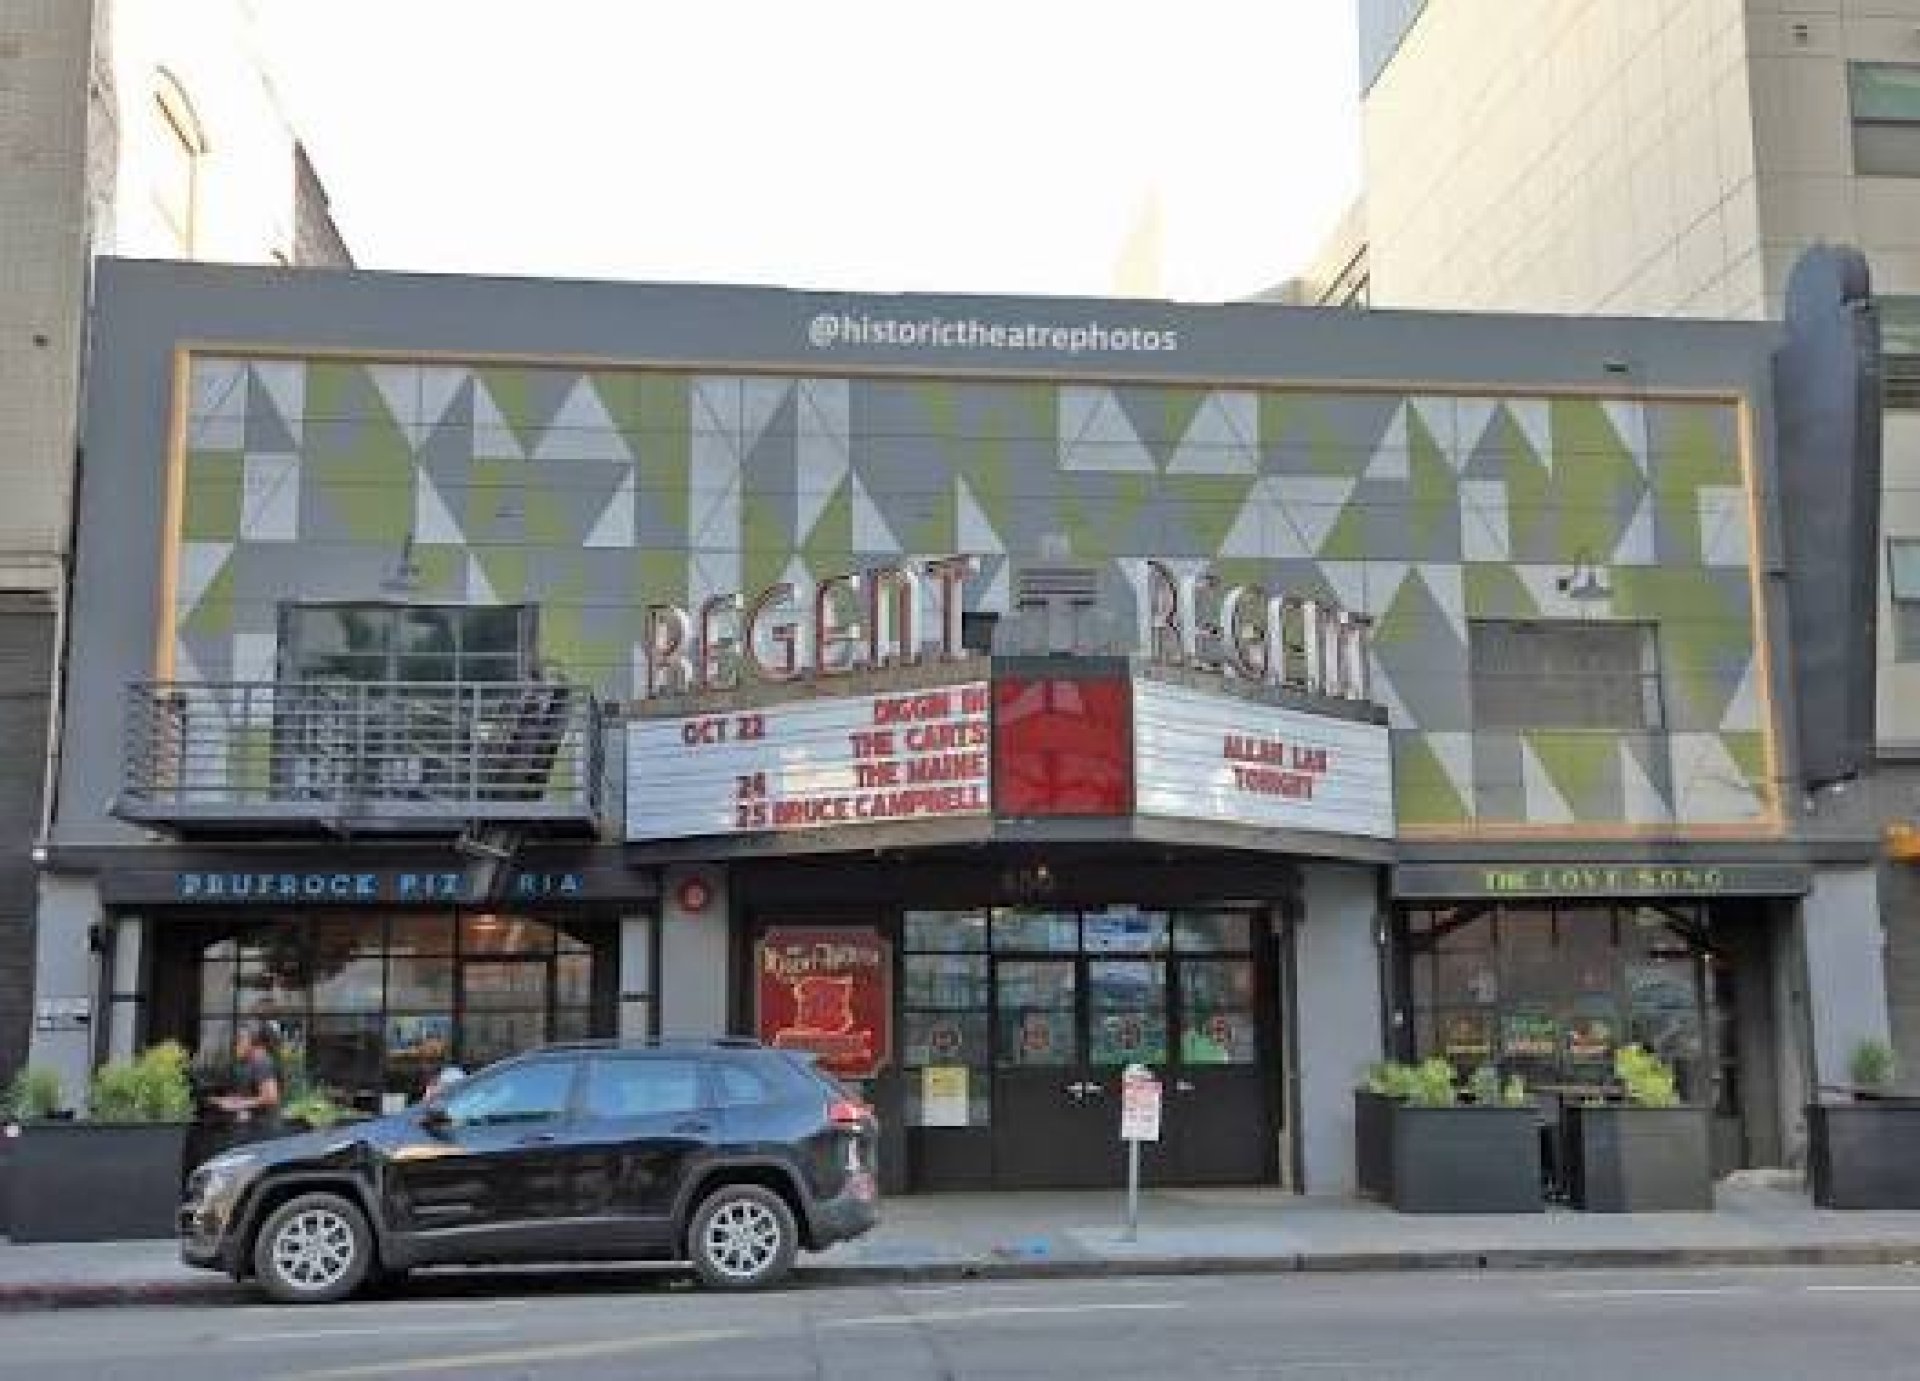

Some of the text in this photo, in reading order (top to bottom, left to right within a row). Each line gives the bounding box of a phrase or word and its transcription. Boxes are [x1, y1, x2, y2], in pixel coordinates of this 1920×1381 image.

[645, 555, 980, 700] REGENT
[683, 718, 728, 746] OCT
[848, 724, 988, 758] THE CARTS
[735, 772, 767, 798] 24
[855, 765, 900, 787] THE
[1233, 767, 1313, 799] TONIGHT
[735, 786, 986, 828] 25 BRUCE CAMPBELL
[180, 872, 580, 896] PRUFROCK PIZRIA
[1484, 870, 1522, 891] THE
[1542, 869, 1618, 890] LOVE
